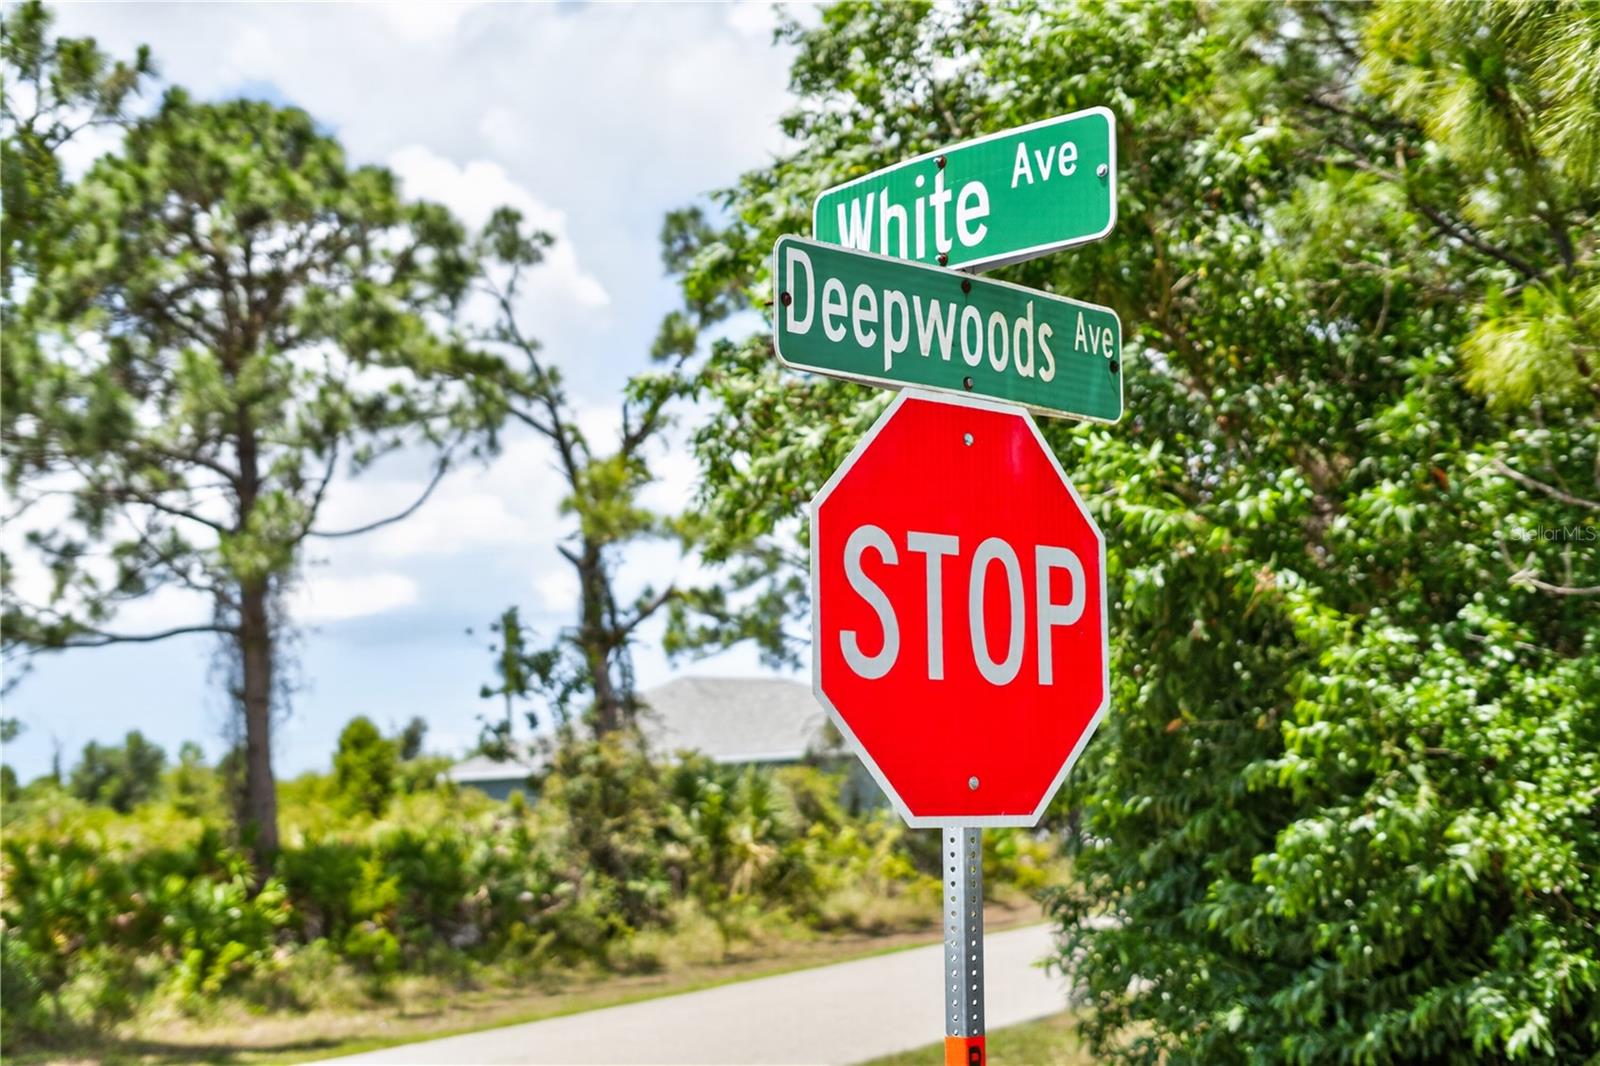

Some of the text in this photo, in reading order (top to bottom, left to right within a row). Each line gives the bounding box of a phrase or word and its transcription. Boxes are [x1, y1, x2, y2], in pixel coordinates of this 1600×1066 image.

[837, 141, 1078, 259] White Ave
[786, 246, 1115, 383] Deepwoods Ave
[839, 524, 1087, 686] STOP
